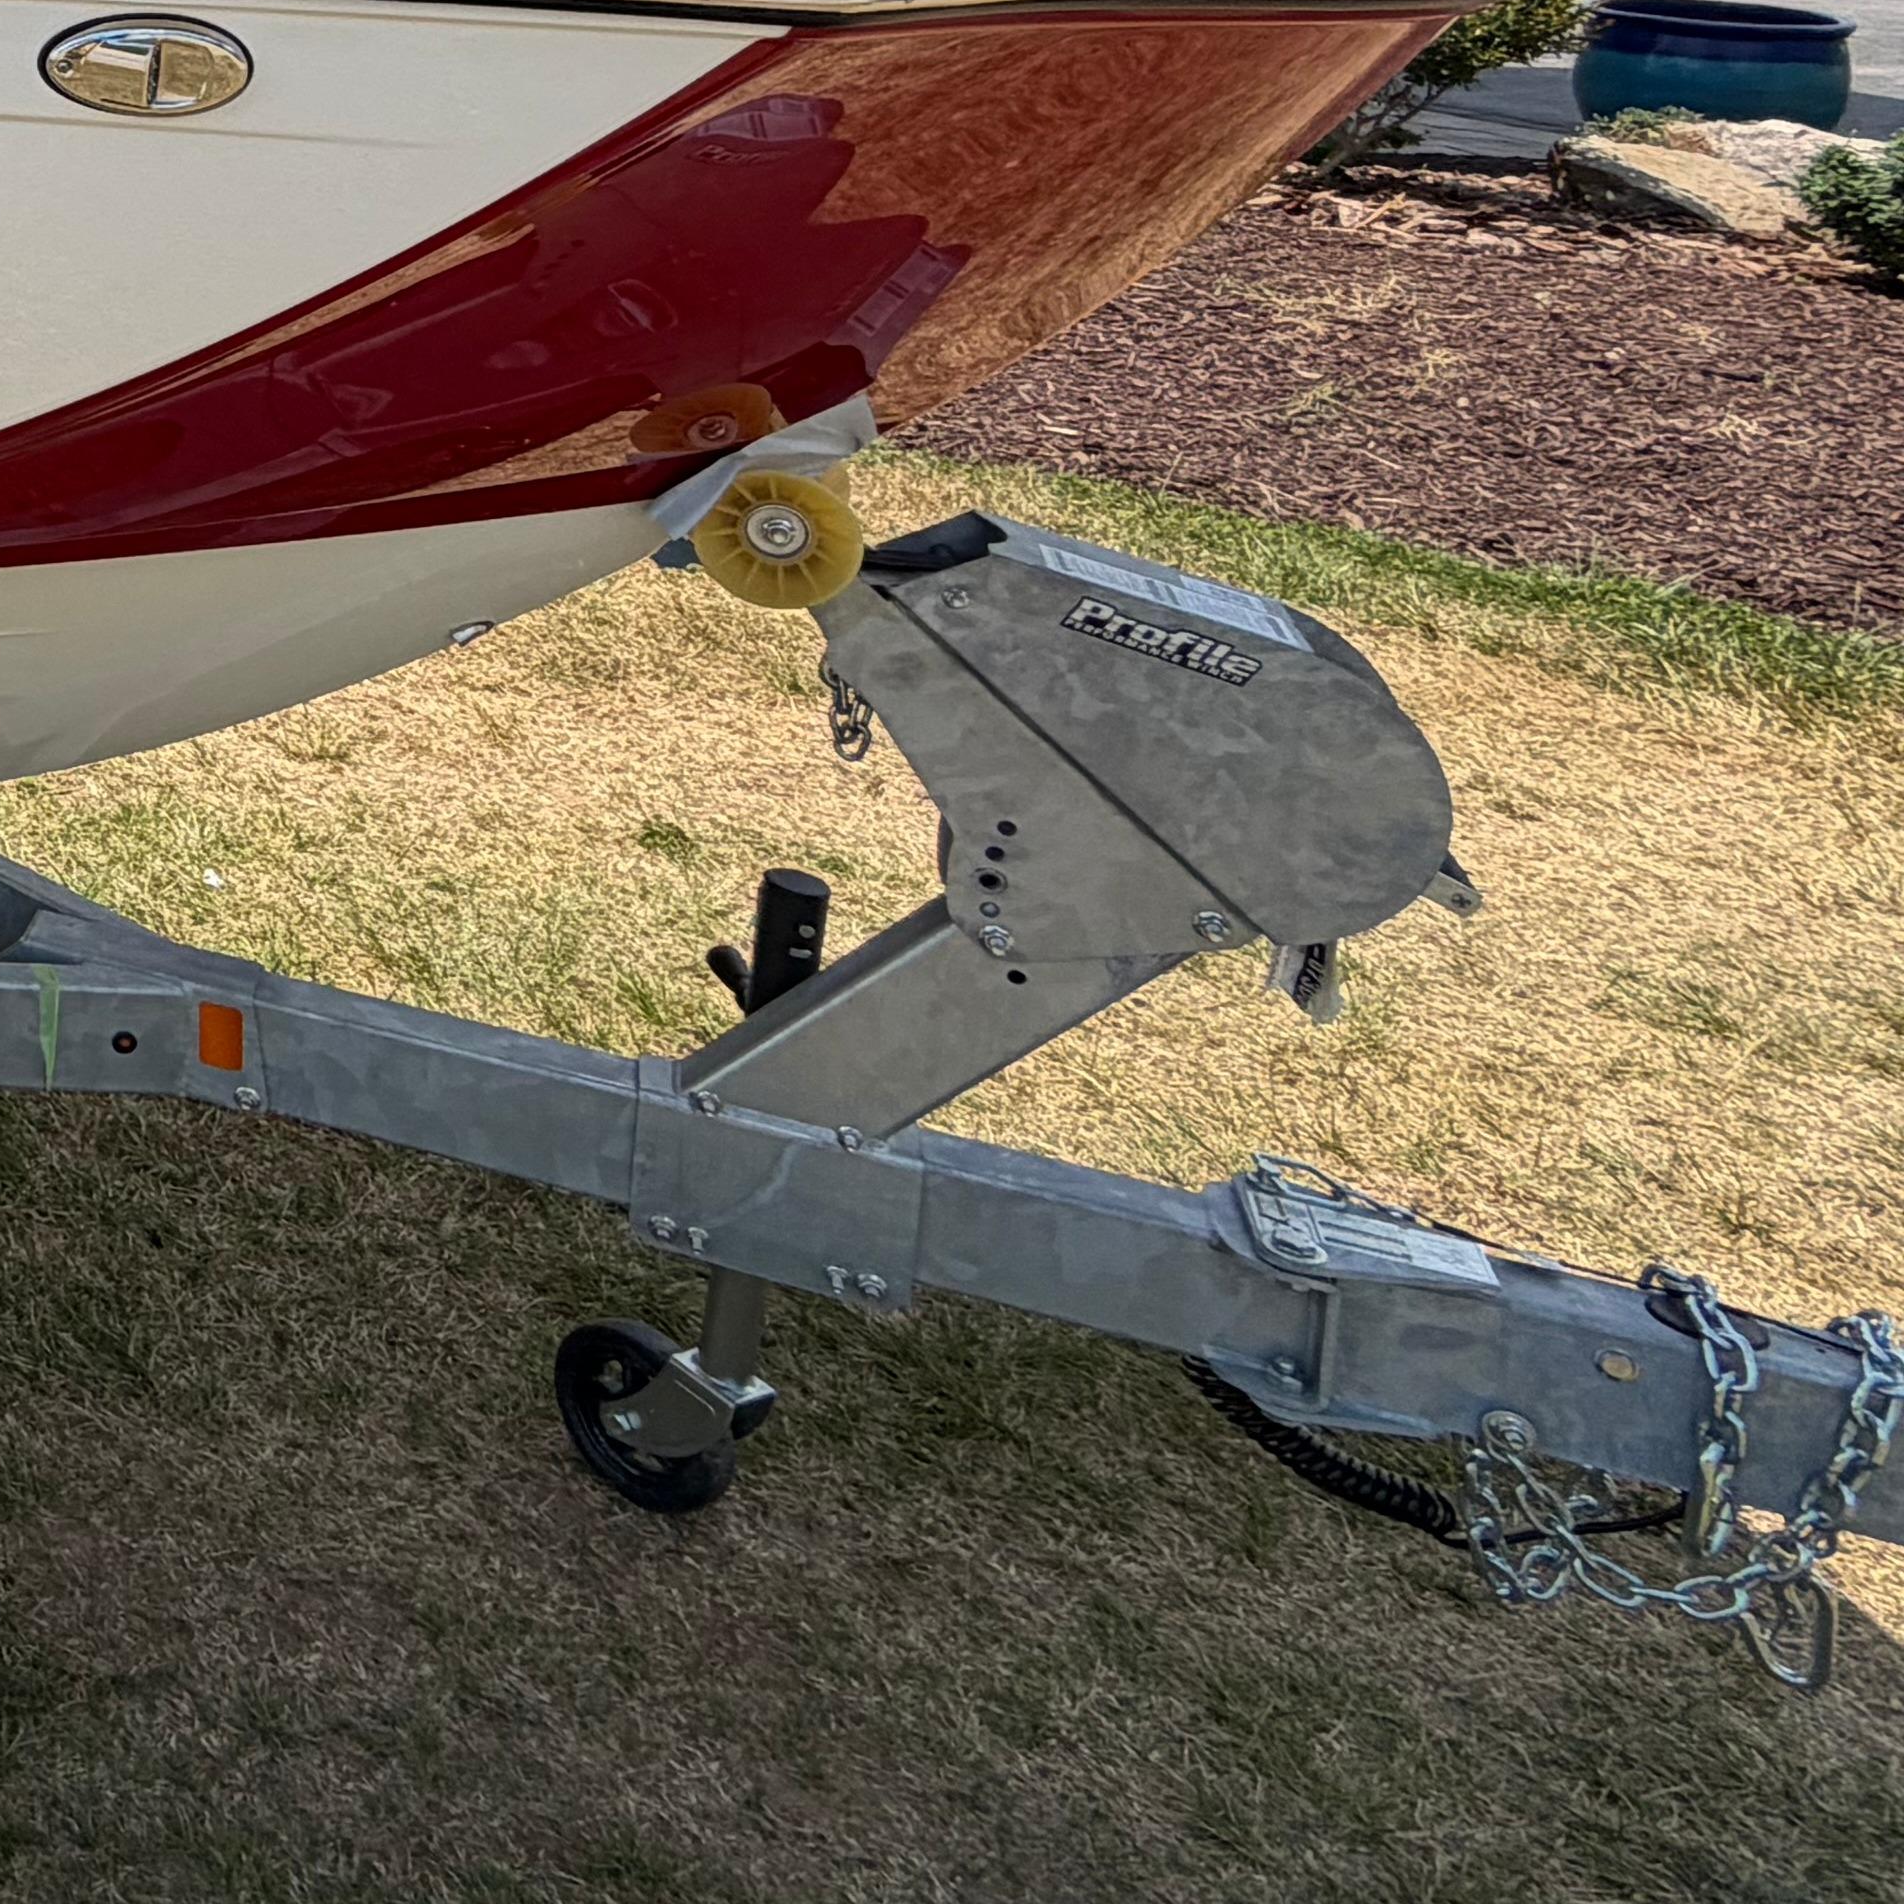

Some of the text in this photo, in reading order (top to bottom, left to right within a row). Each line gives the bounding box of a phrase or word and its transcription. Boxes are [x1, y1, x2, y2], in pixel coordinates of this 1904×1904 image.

[1064, 618, 1244, 685] PERFORMANCE WINCH
[1068, 597, 1262, 678] Profile
